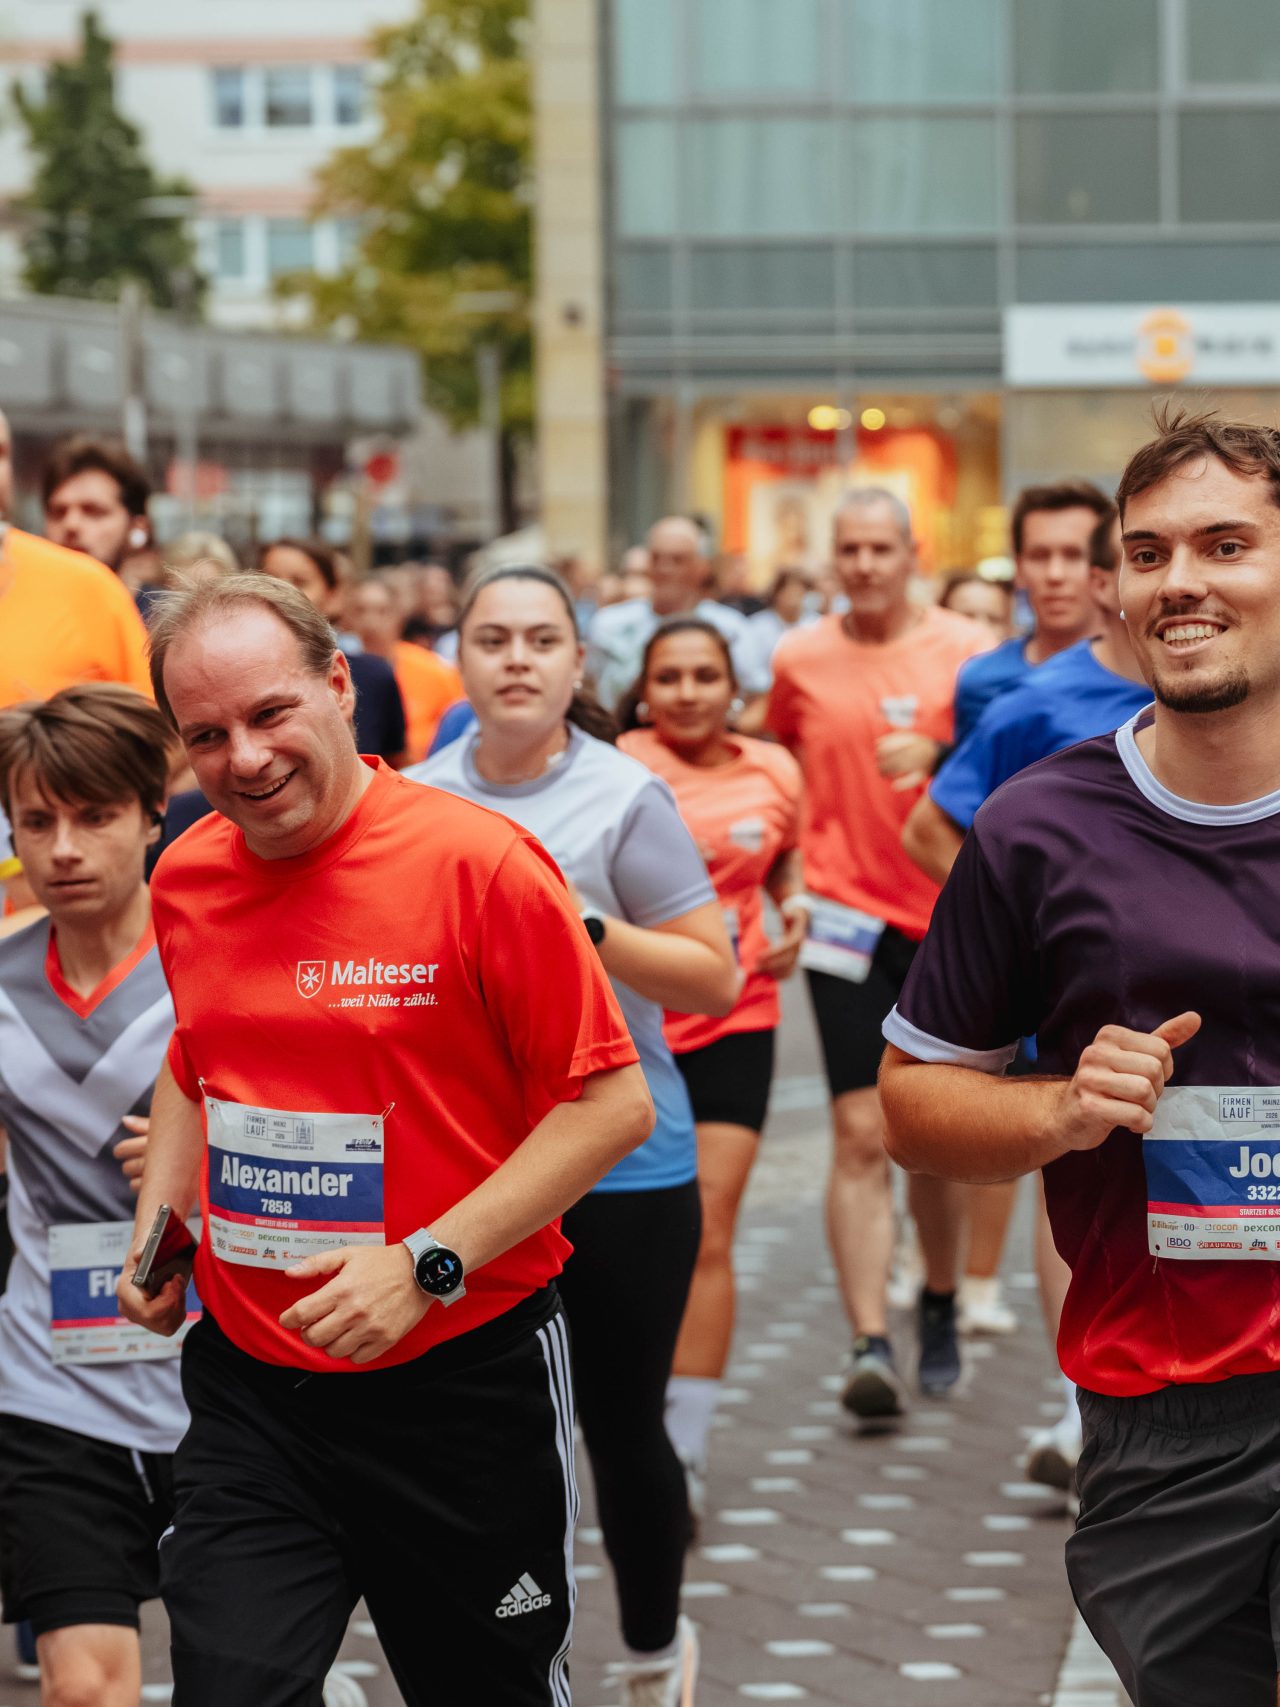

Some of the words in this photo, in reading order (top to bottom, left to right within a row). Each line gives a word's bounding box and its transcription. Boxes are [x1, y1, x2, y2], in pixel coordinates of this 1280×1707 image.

[331, 957, 439, 986] Malteser
[328, 993, 365, 1008] ...weil
[366, 993, 400, 1008] Nähe
[403, 992, 439, 1007] zählt.
[1222, 1097, 1251, 1106] FIRMEN
[1262, 1098, 1280, 1106] MAINZ
[1222, 1107, 1251, 1119] LAUF
[246, 1115, 266, 1125] FIRMEN
[246, 1124, 266, 1137] LAUF
[220, 1154, 354, 1197] Alexander
[261, 1198, 293, 1215] 7858
[1239, 1208, 1267, 1216] STARTZEIT
[1169, 1237, 1191, 1247] BDO
[1252, 1239, 1266, 1247] dm
[88, 1269, 120, 1298] Fl
[495, 1594, 552, 1618] adidas
